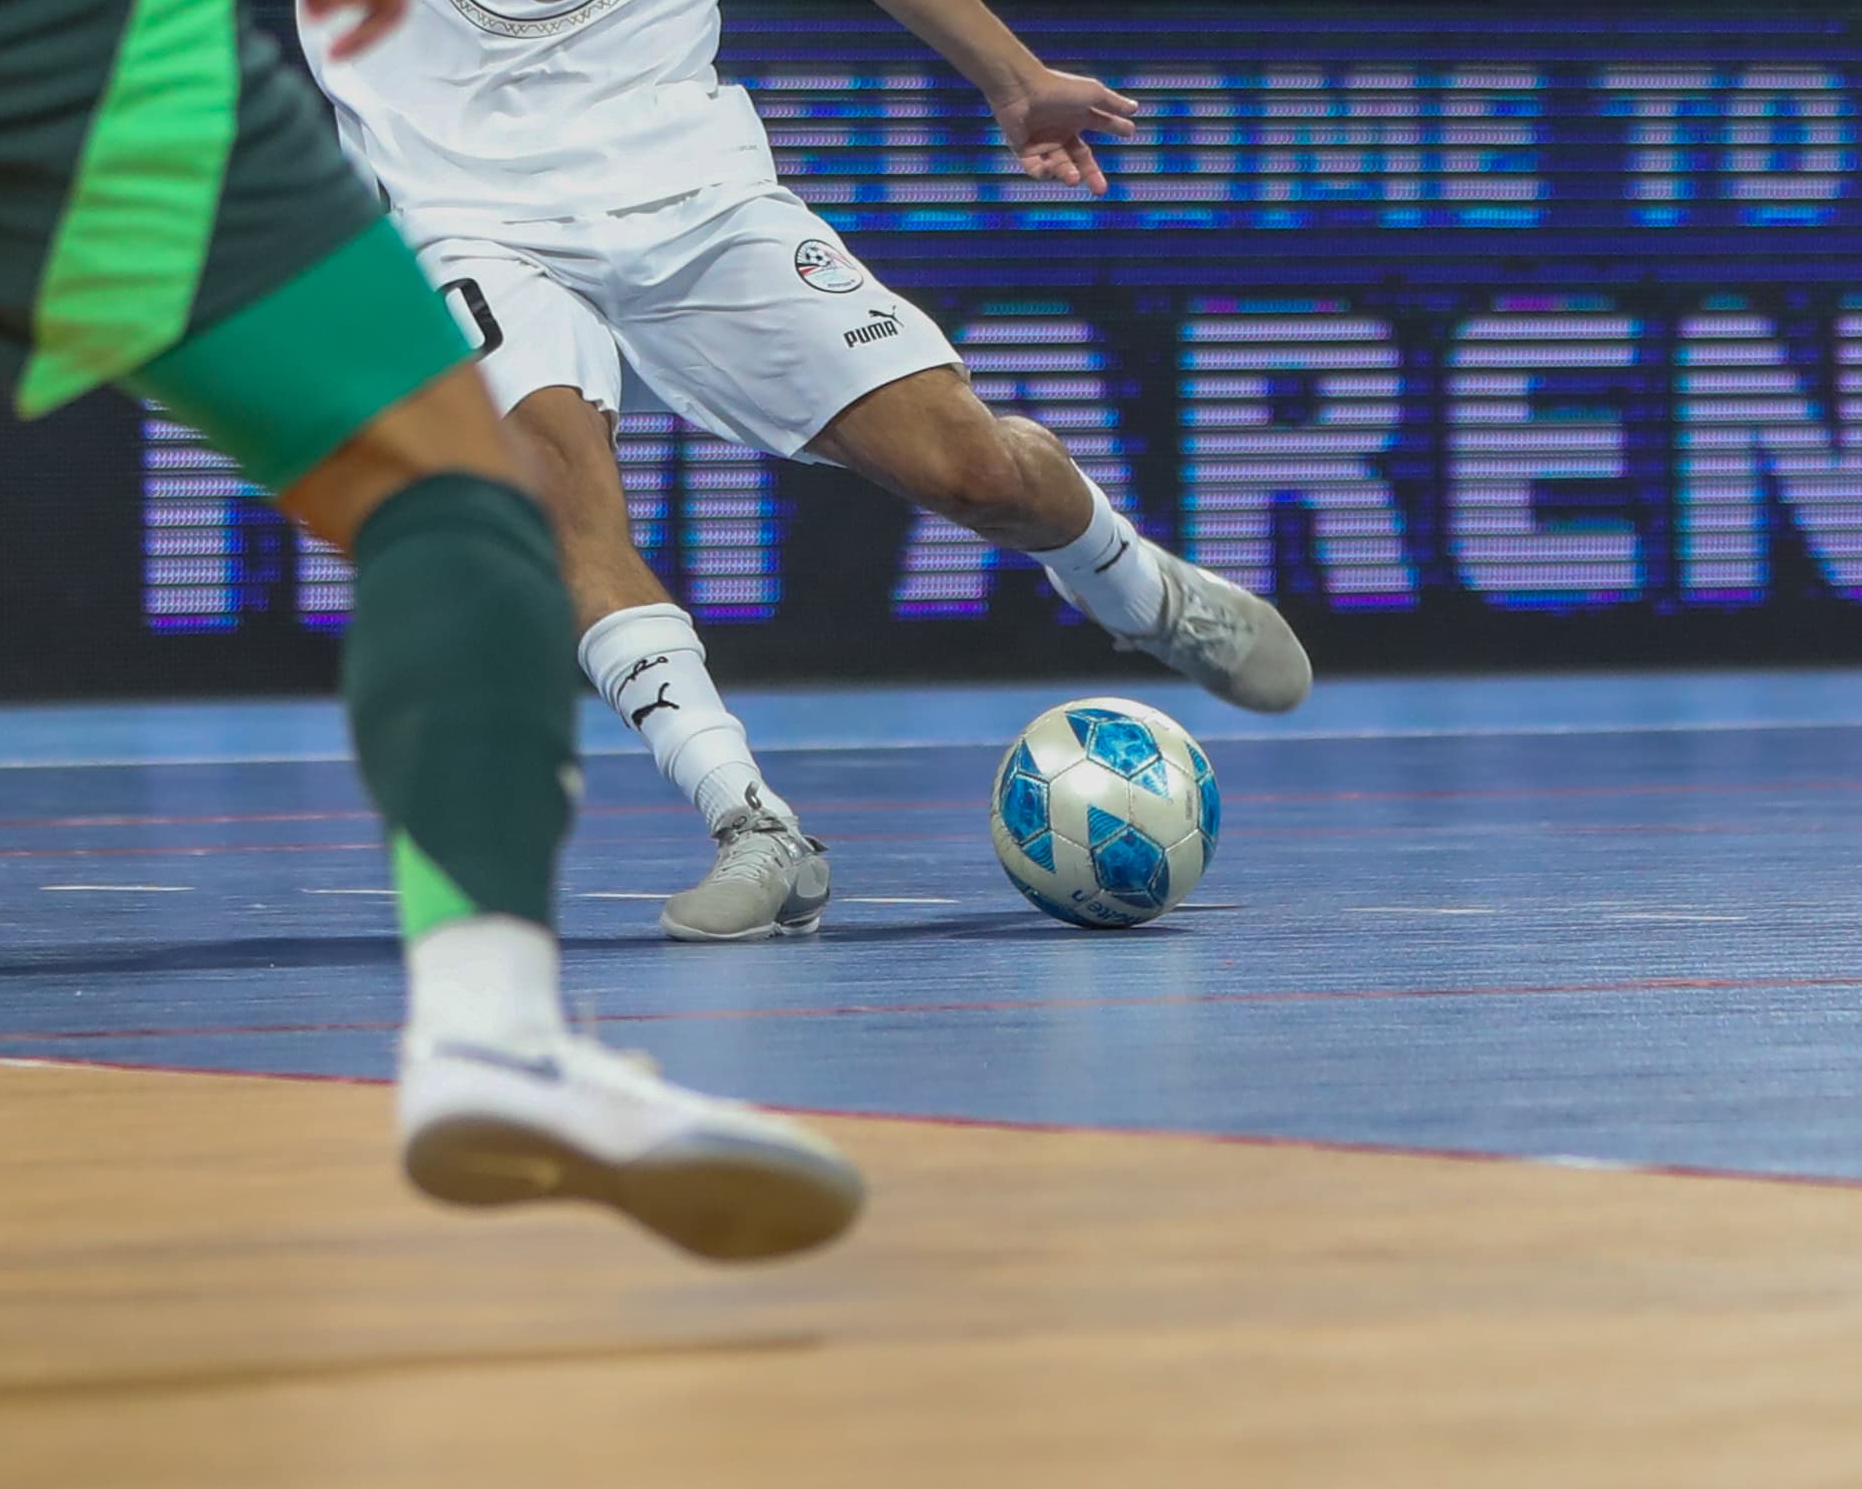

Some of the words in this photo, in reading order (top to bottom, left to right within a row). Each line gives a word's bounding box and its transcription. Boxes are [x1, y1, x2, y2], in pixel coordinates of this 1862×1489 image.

[721, 67, 1540, 228] ELOME
[1598, 67, 1846, 228] TO
[843, 320, 899, 348] PUMA
